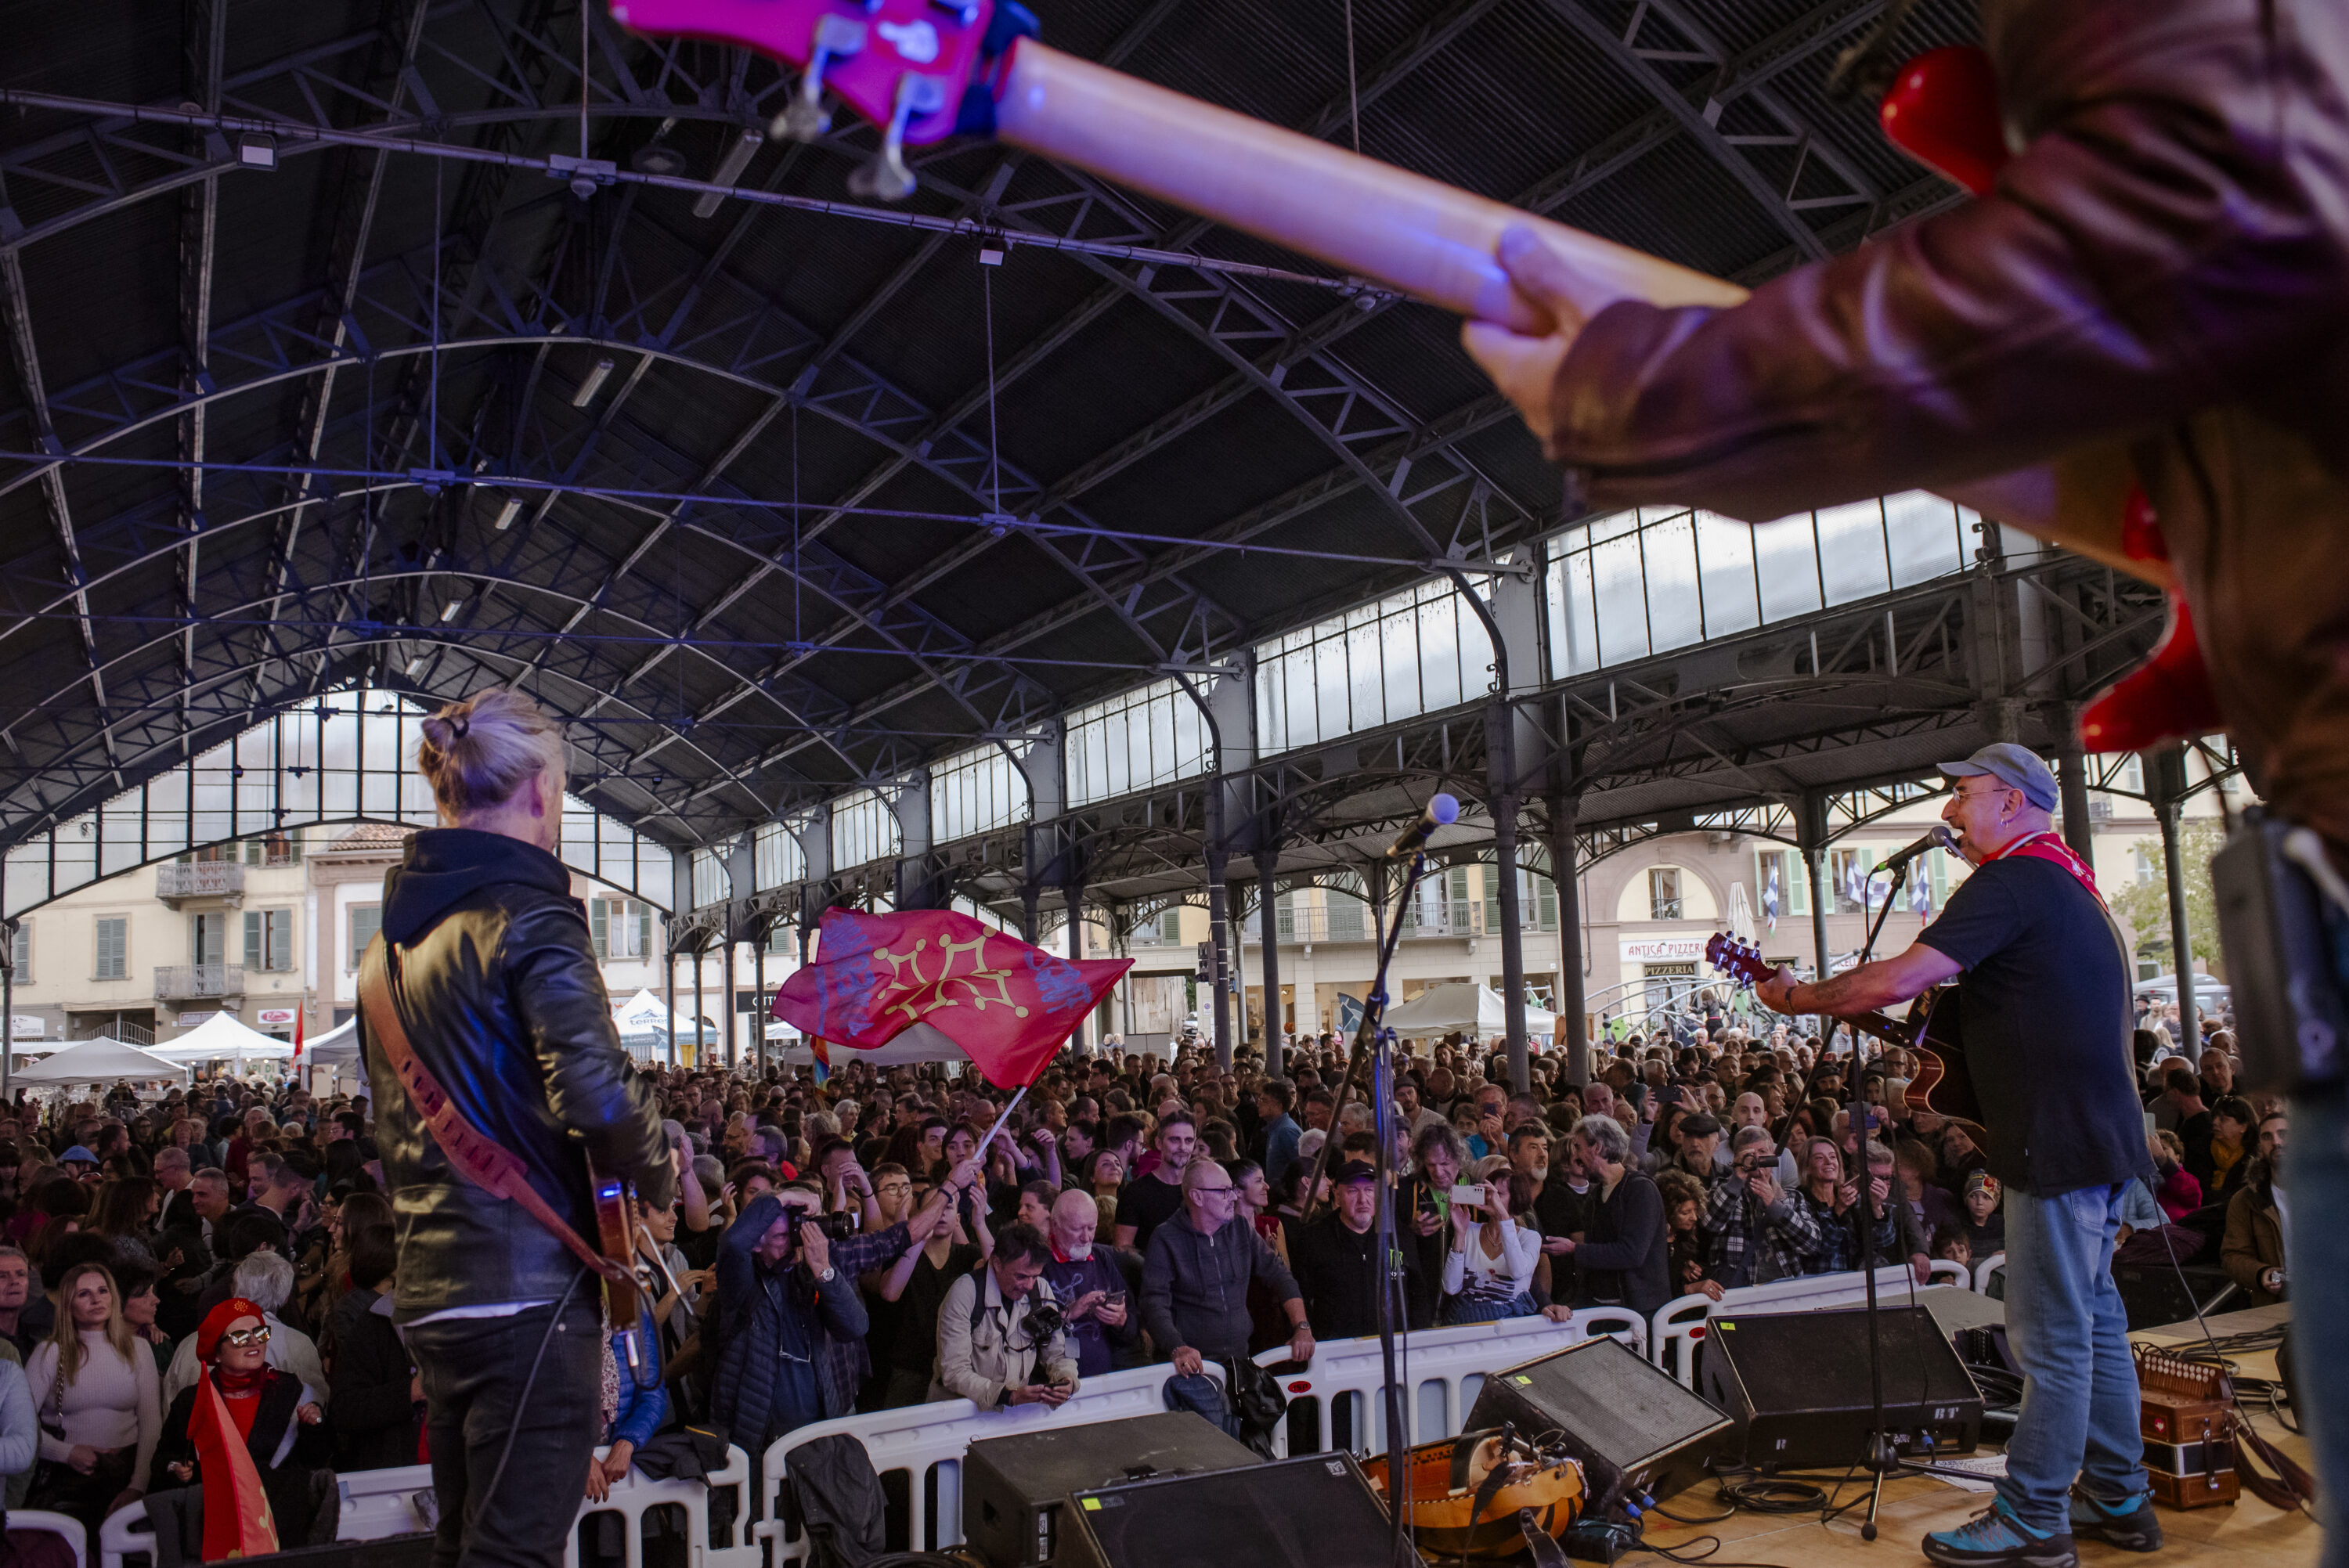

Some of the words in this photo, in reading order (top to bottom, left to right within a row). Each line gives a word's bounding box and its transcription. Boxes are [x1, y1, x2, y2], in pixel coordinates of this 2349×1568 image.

[1629, 944, 1662, 956] ANTICA
[1669, 943, 1706, 954] PIZZERI
[1645, 964, 1694, 975] PIZZERIA
